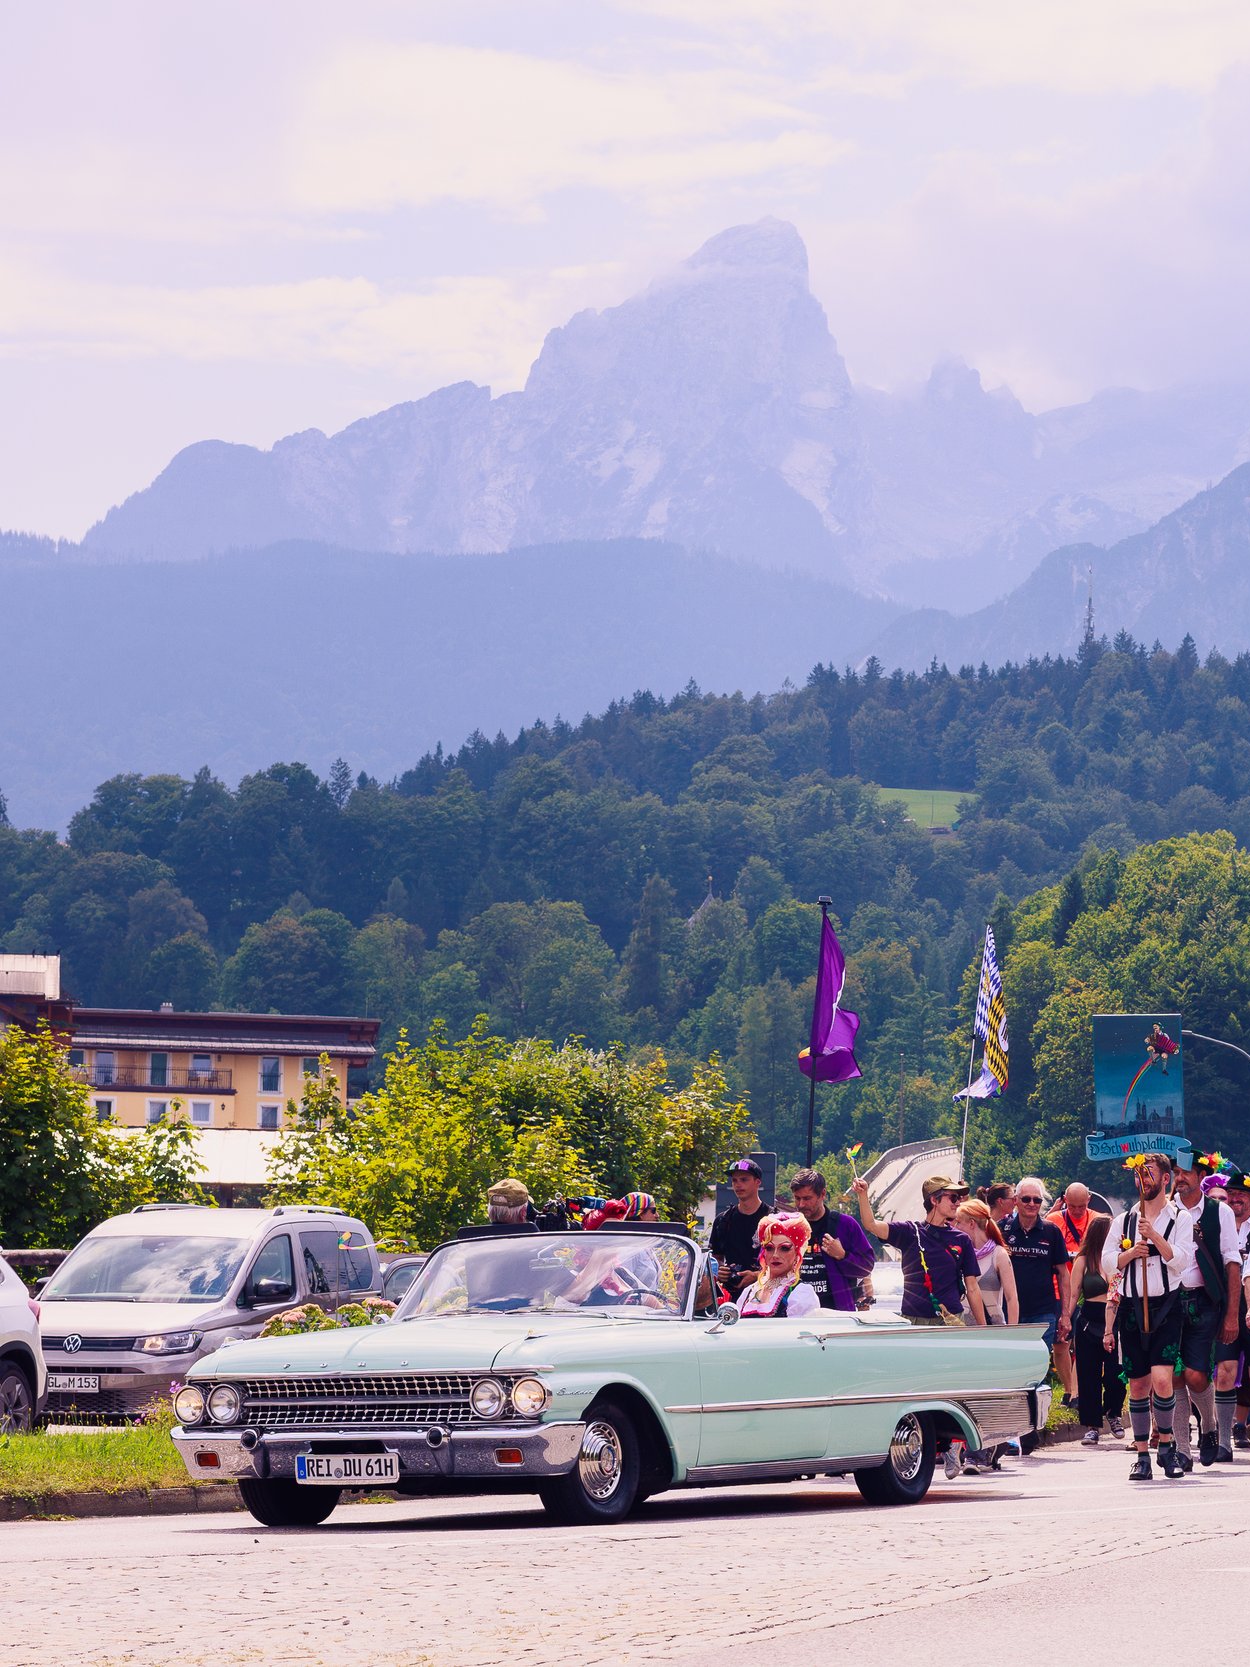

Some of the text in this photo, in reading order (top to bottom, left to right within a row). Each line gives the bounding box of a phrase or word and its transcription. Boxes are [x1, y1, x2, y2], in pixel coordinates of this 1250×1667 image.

[1031, 1247, 1049, 1255] TEAM
[48, 1376, 98, 1388] GL M 153
[306, 1458, 333, 1477] REI
[343, 1458, 362, 1477] DU
[365, 1458, 394, 1477] 61H
